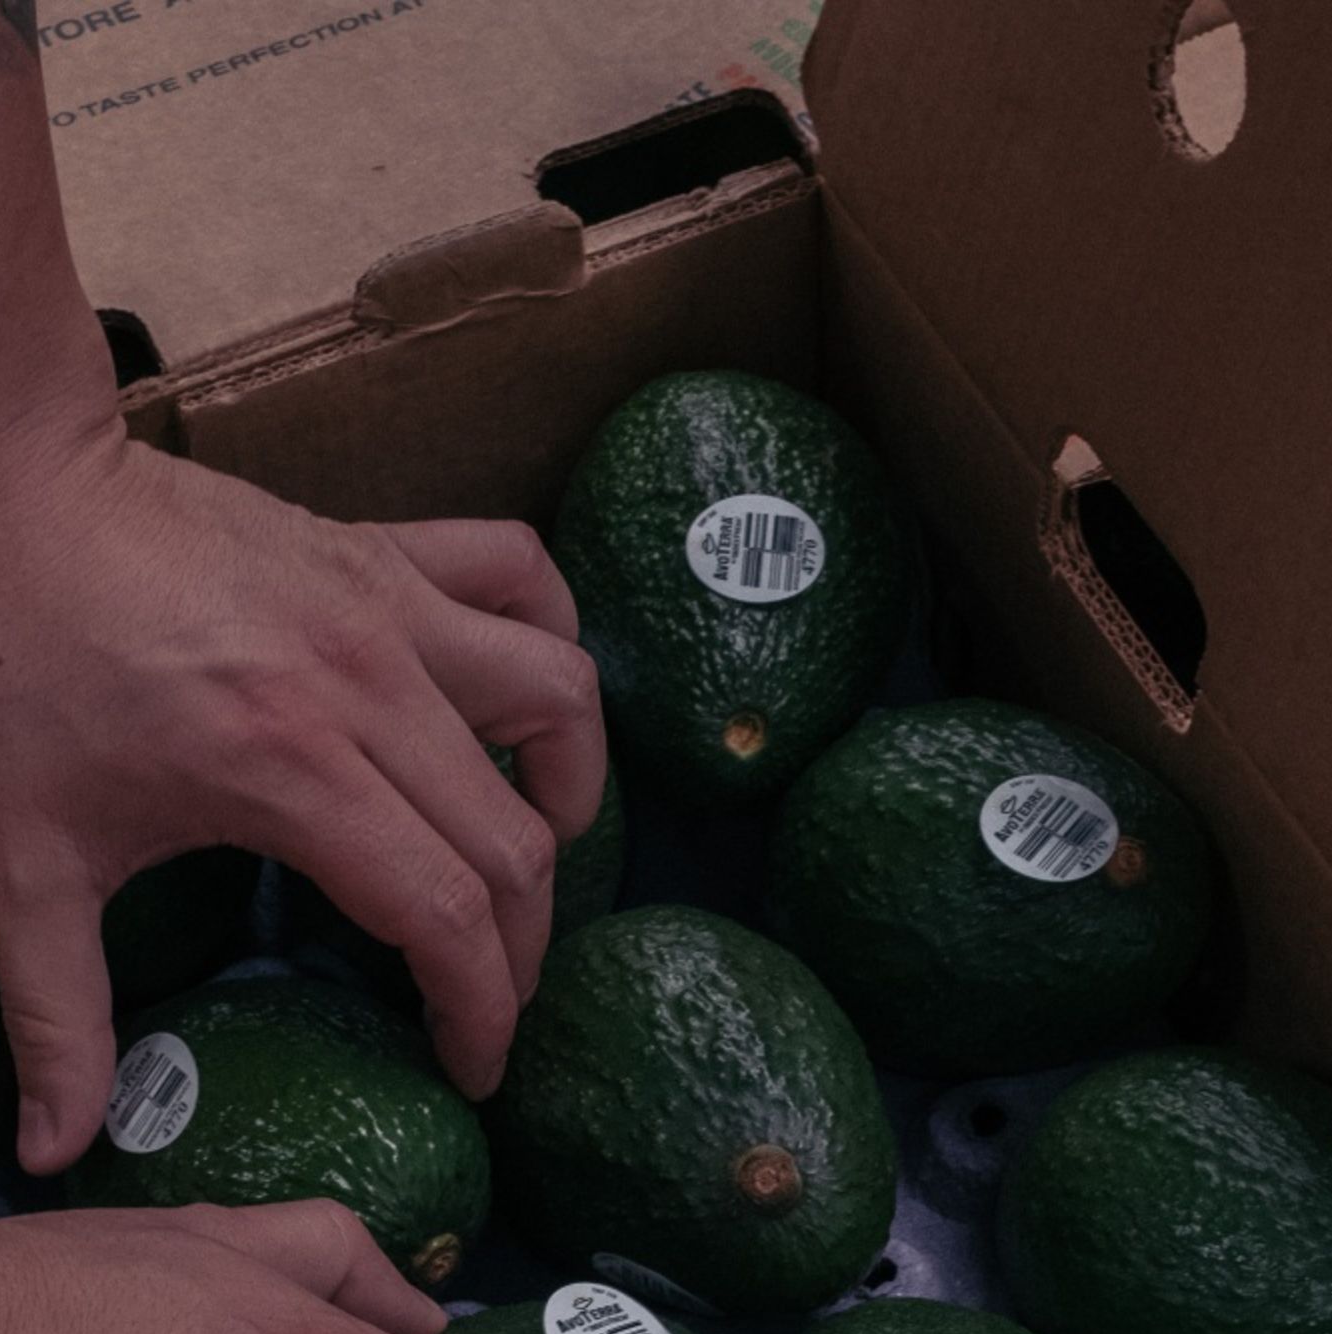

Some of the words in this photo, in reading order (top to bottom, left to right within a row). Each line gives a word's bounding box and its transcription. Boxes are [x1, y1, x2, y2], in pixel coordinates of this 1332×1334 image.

[38, 1, 142, 47] TORE
[78, 77, 182, 117] TASTE
[186, 9, 383, 83] PERFECTION
[802, 538, 818, 575] 4770
[1080, 840, 1109, 871] 4770
[164, 1101, 188, 1139] 4770
